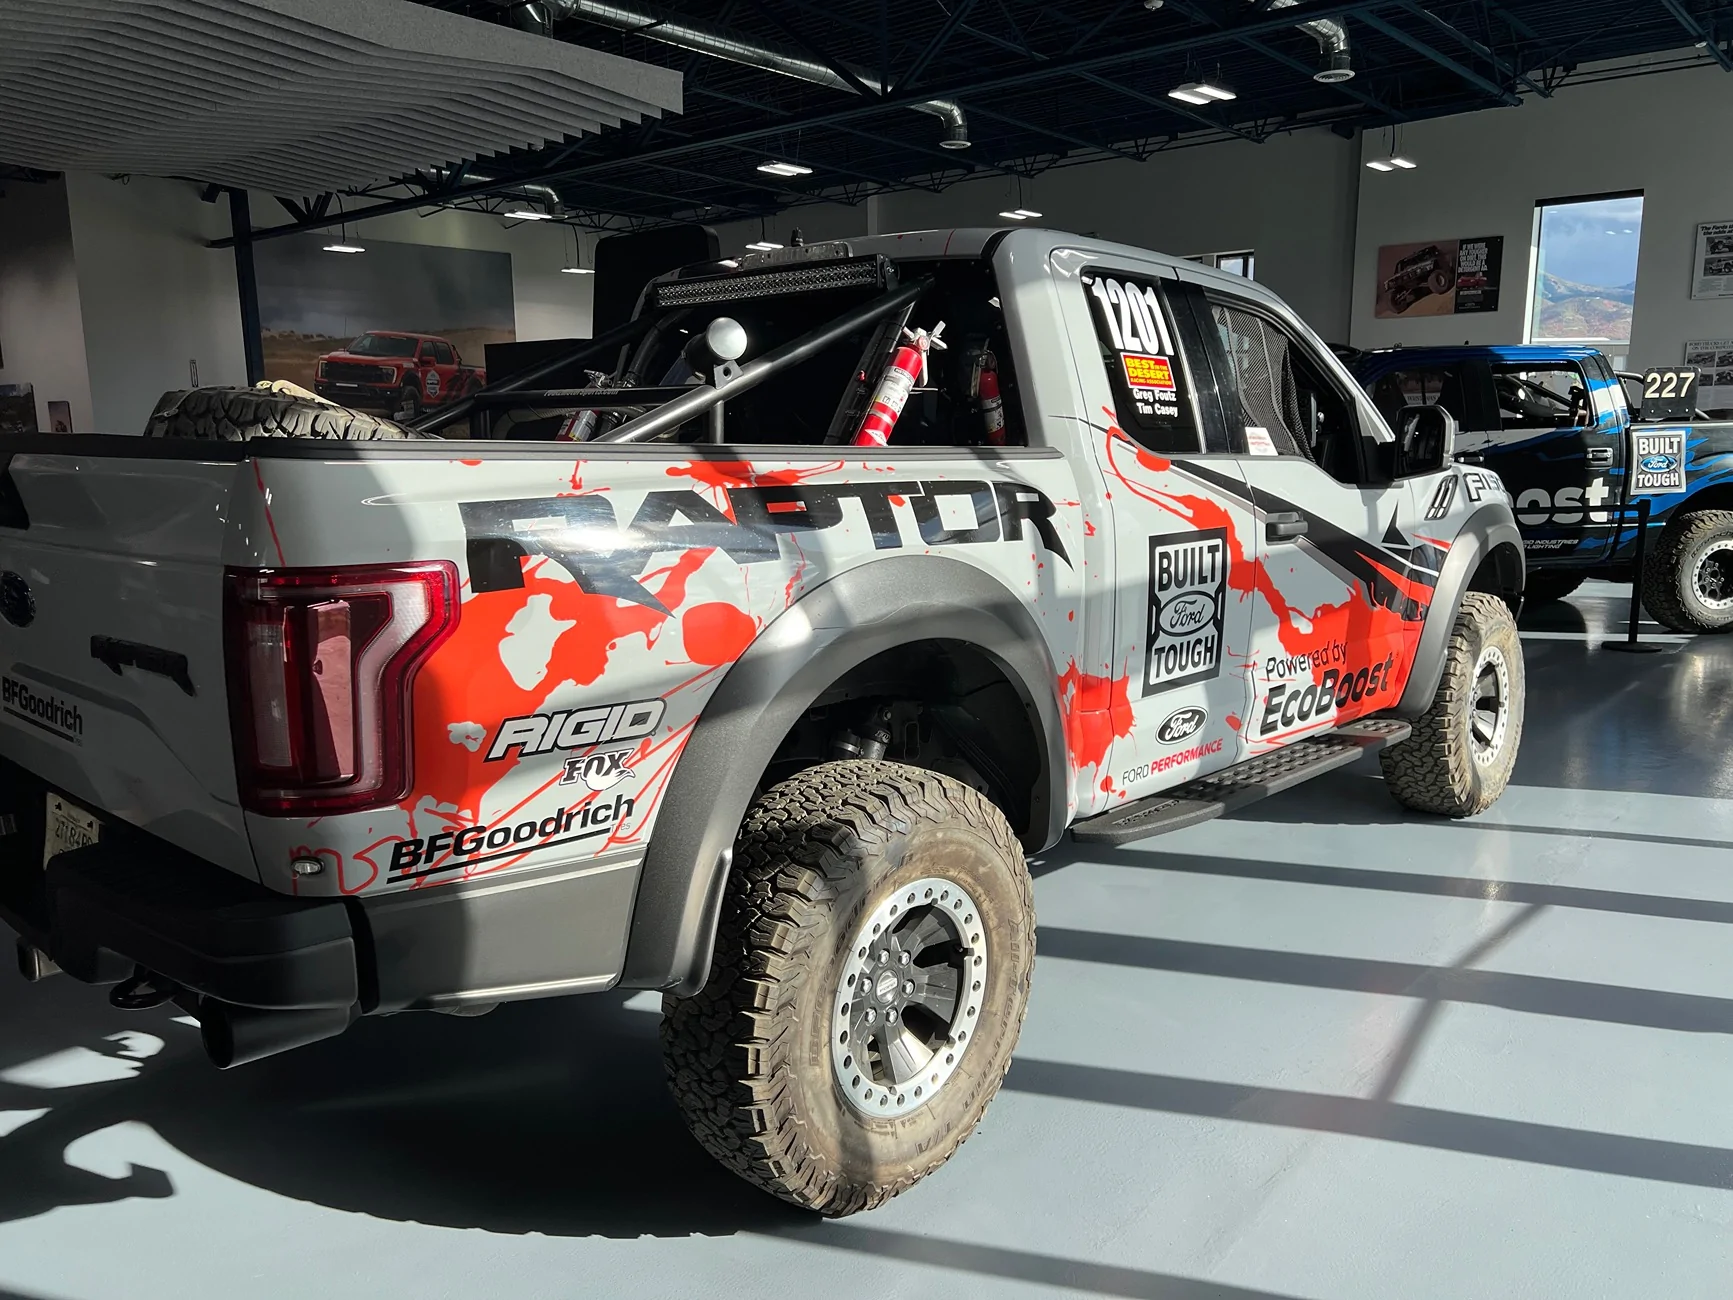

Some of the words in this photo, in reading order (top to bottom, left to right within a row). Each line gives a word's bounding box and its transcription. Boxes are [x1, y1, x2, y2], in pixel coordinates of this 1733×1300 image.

[1092, 277, 1175, 356] 1201
[1125, 358, 1155, 369] BEST
[1128, 368, 1169, 380] DESERT
[1133, 388, 1153, 402] Greg
[1154, 389, 1177, 402] Foutz
[1645, 372, 1695, 398] 227
[1136, 402, 1153, 415] Tim
[1154, 402, 1178, 418] Casey
[1639, 437, 1680, 454] BUILT
[1648, 457, 1669, 469] Ford
[1637, 473, 1680, 487] TOUGH
[458, 480, 1074, 619] RAPTOR
[1158, 544, 1220, 592] BUILT
[1169, 599, 1205, 631] Ford
[1154, 635, 1216, 678] TOUGH
[1266, 640, 1331, 682] Powered
[1333, 639, 1347, 665] by
[2, 676, 83, 735] BFGoodrich
[1260, 652, 1393, 736] EcoBoost
[483, 697, 667, 762] RIGID
[1165, 712, 1200, 739] Ford
[559, 748, 635, 790] FOX
[1122, 763, 1150, 785] FORD
[1151, 738, 1223, 775] PERFORMANCE
[389, 794, 635, 873] BFGoodrich
